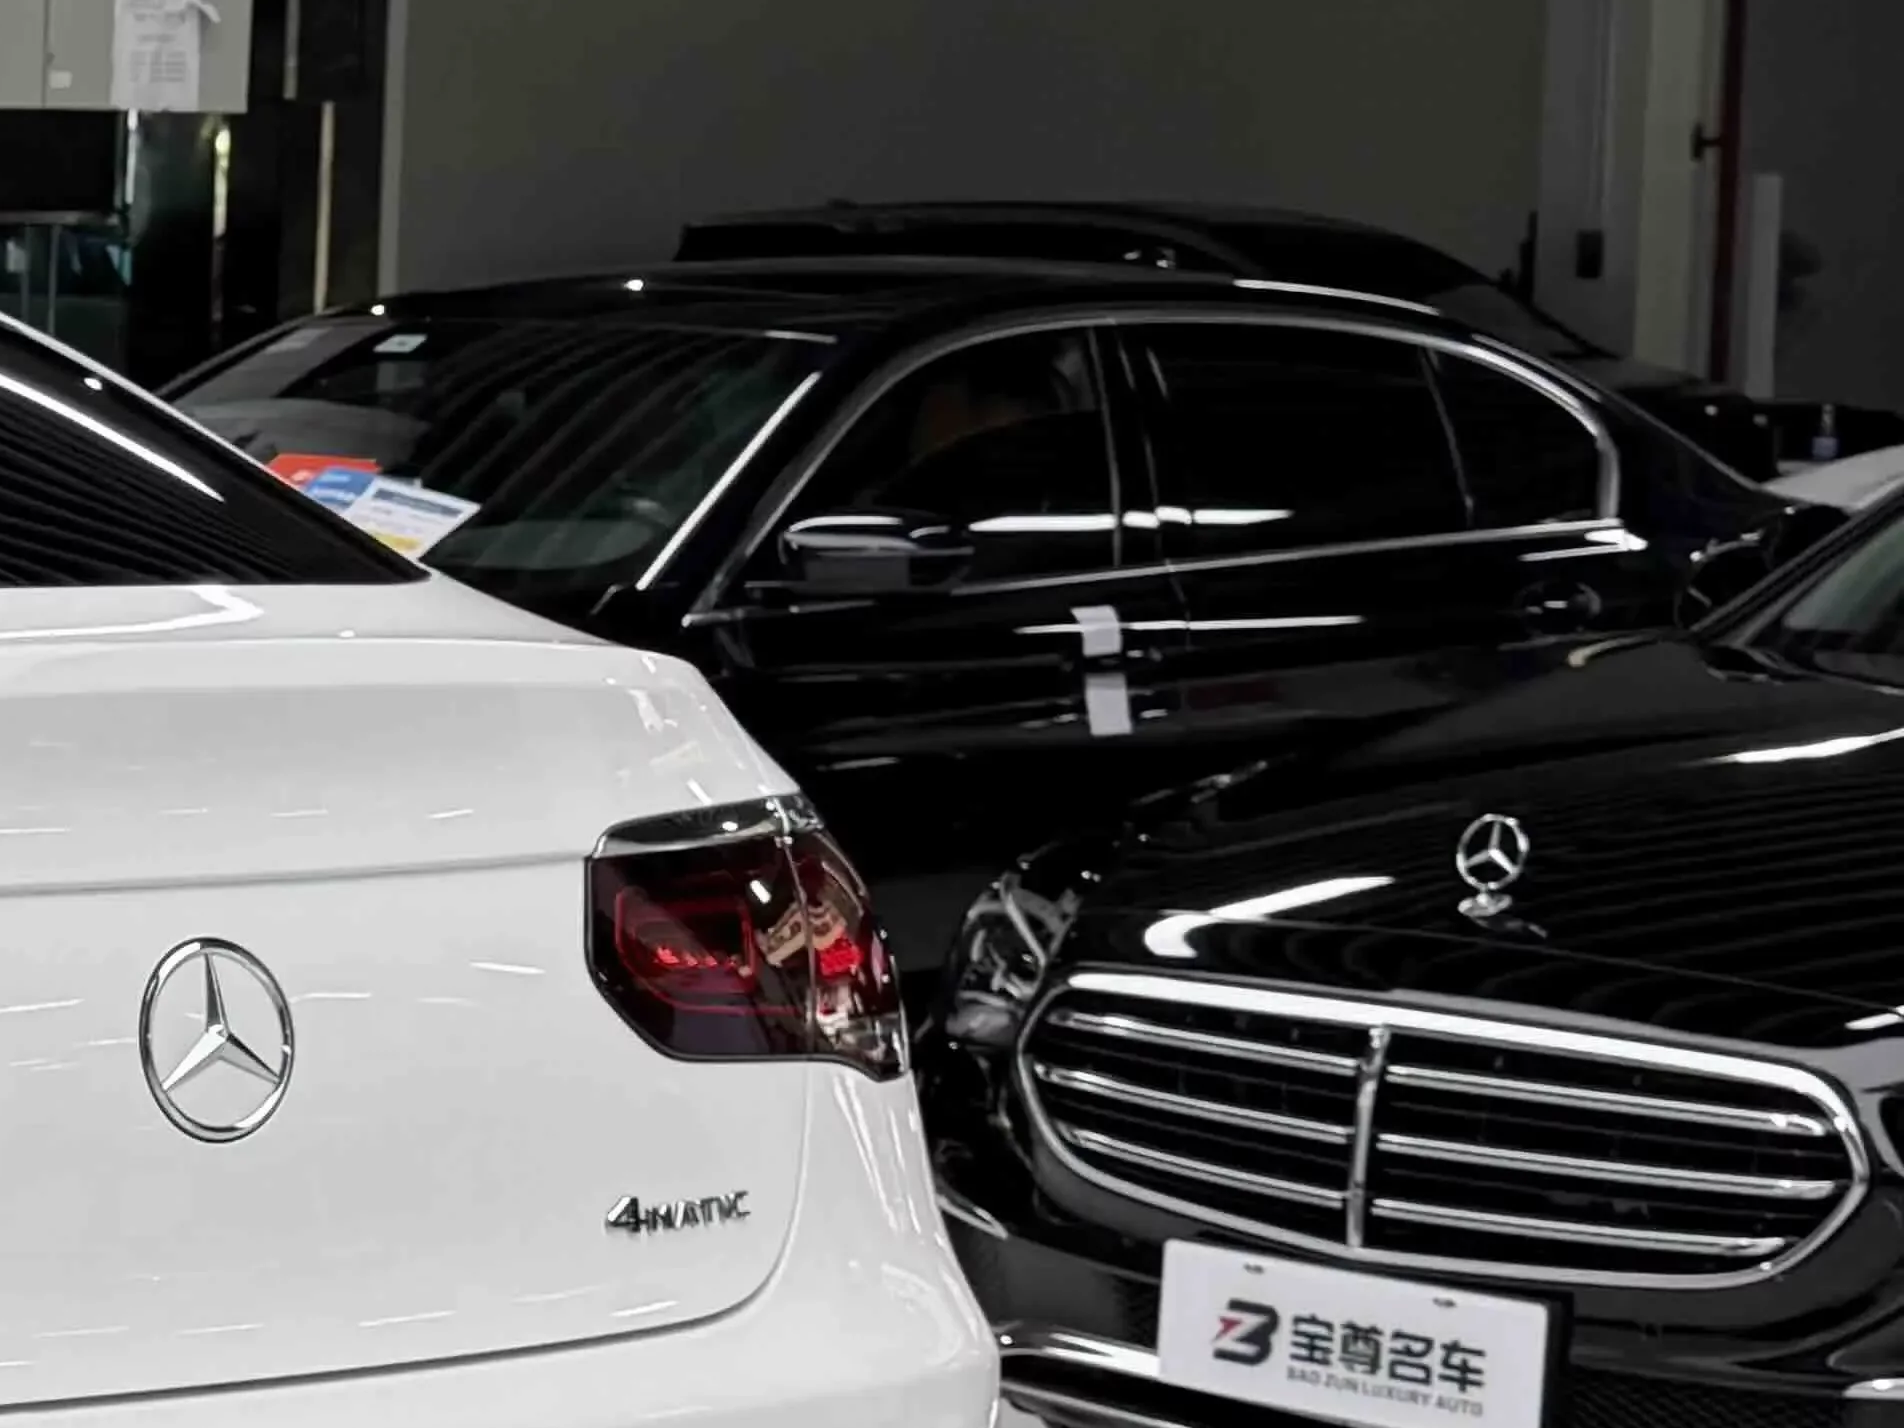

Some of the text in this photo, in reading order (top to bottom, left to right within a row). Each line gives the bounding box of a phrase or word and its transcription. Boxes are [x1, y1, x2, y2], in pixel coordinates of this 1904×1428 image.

[604, 1189, 751, 1233] 4MATIC
[1289, 1313, 1487, 1393] 宝尊名车
[1287, 1365, 1485, 1418] BAO ZUN LUXURY AUTO
